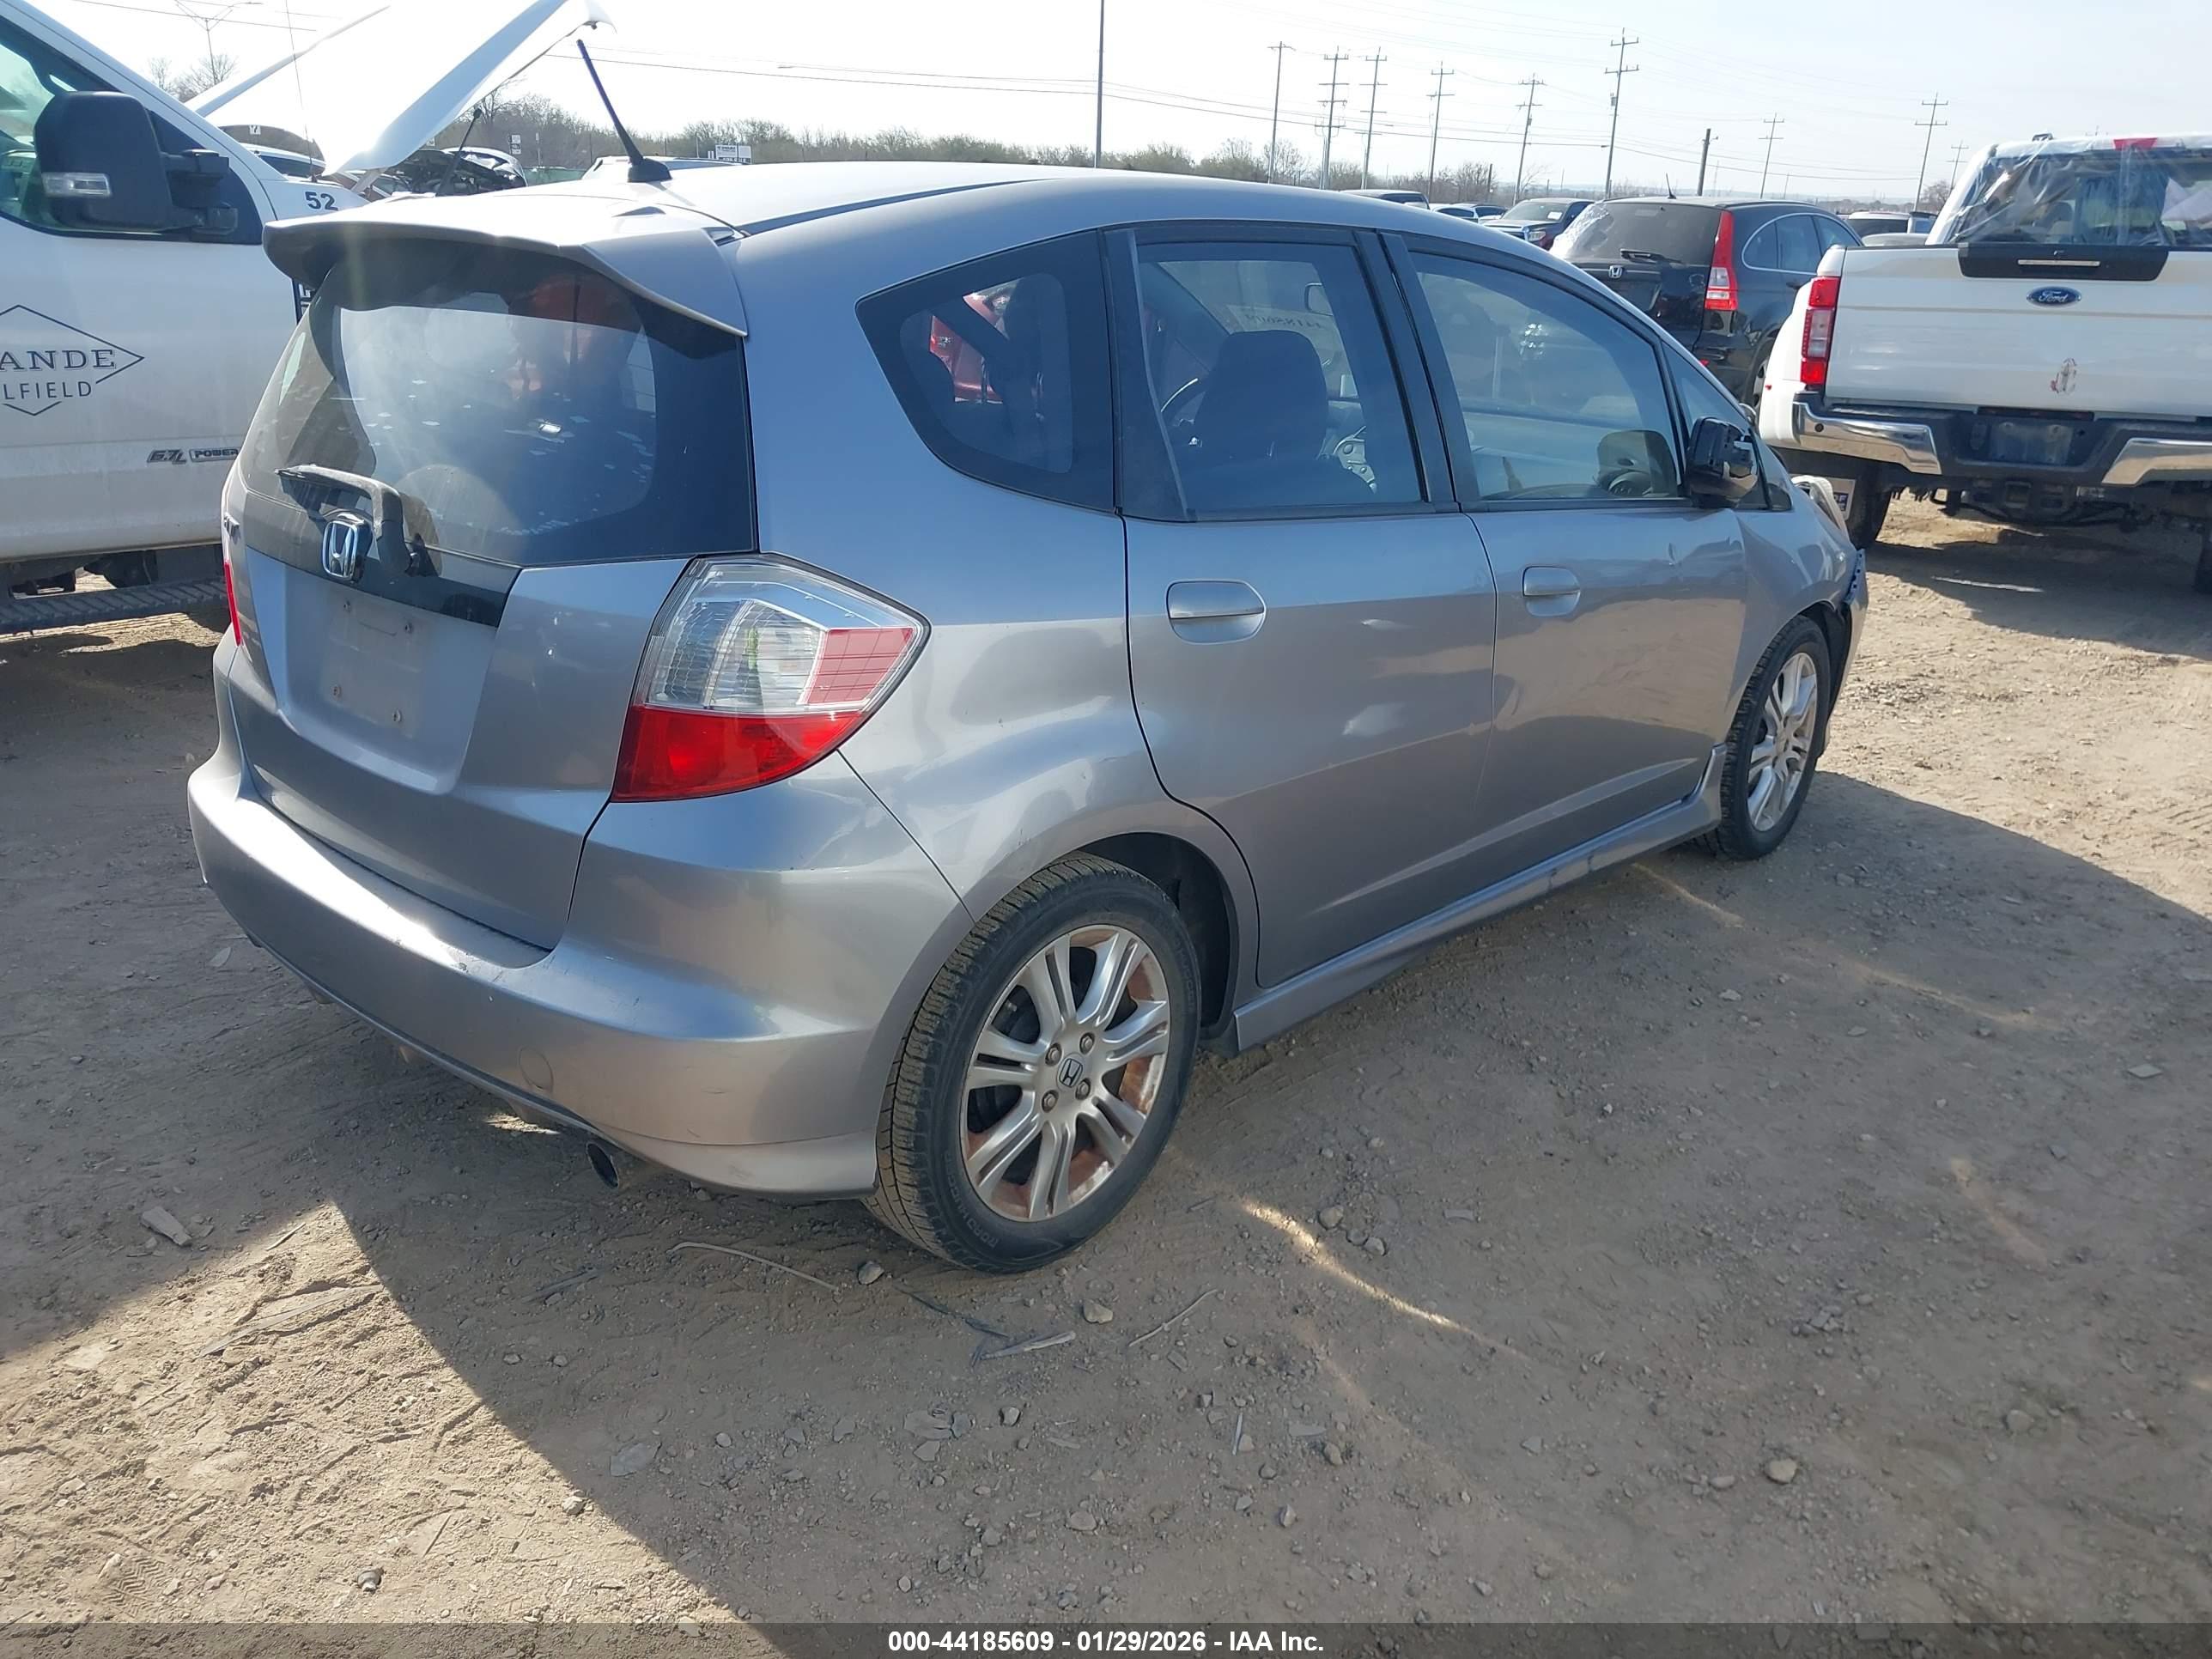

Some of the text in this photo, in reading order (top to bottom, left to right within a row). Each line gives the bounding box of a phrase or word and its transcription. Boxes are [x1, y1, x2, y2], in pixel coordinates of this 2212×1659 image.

[305, 191, 338, 211] 52
[2039, 291, 2069, 303] Ford
[3, 381, 92, 400] LFIELD
